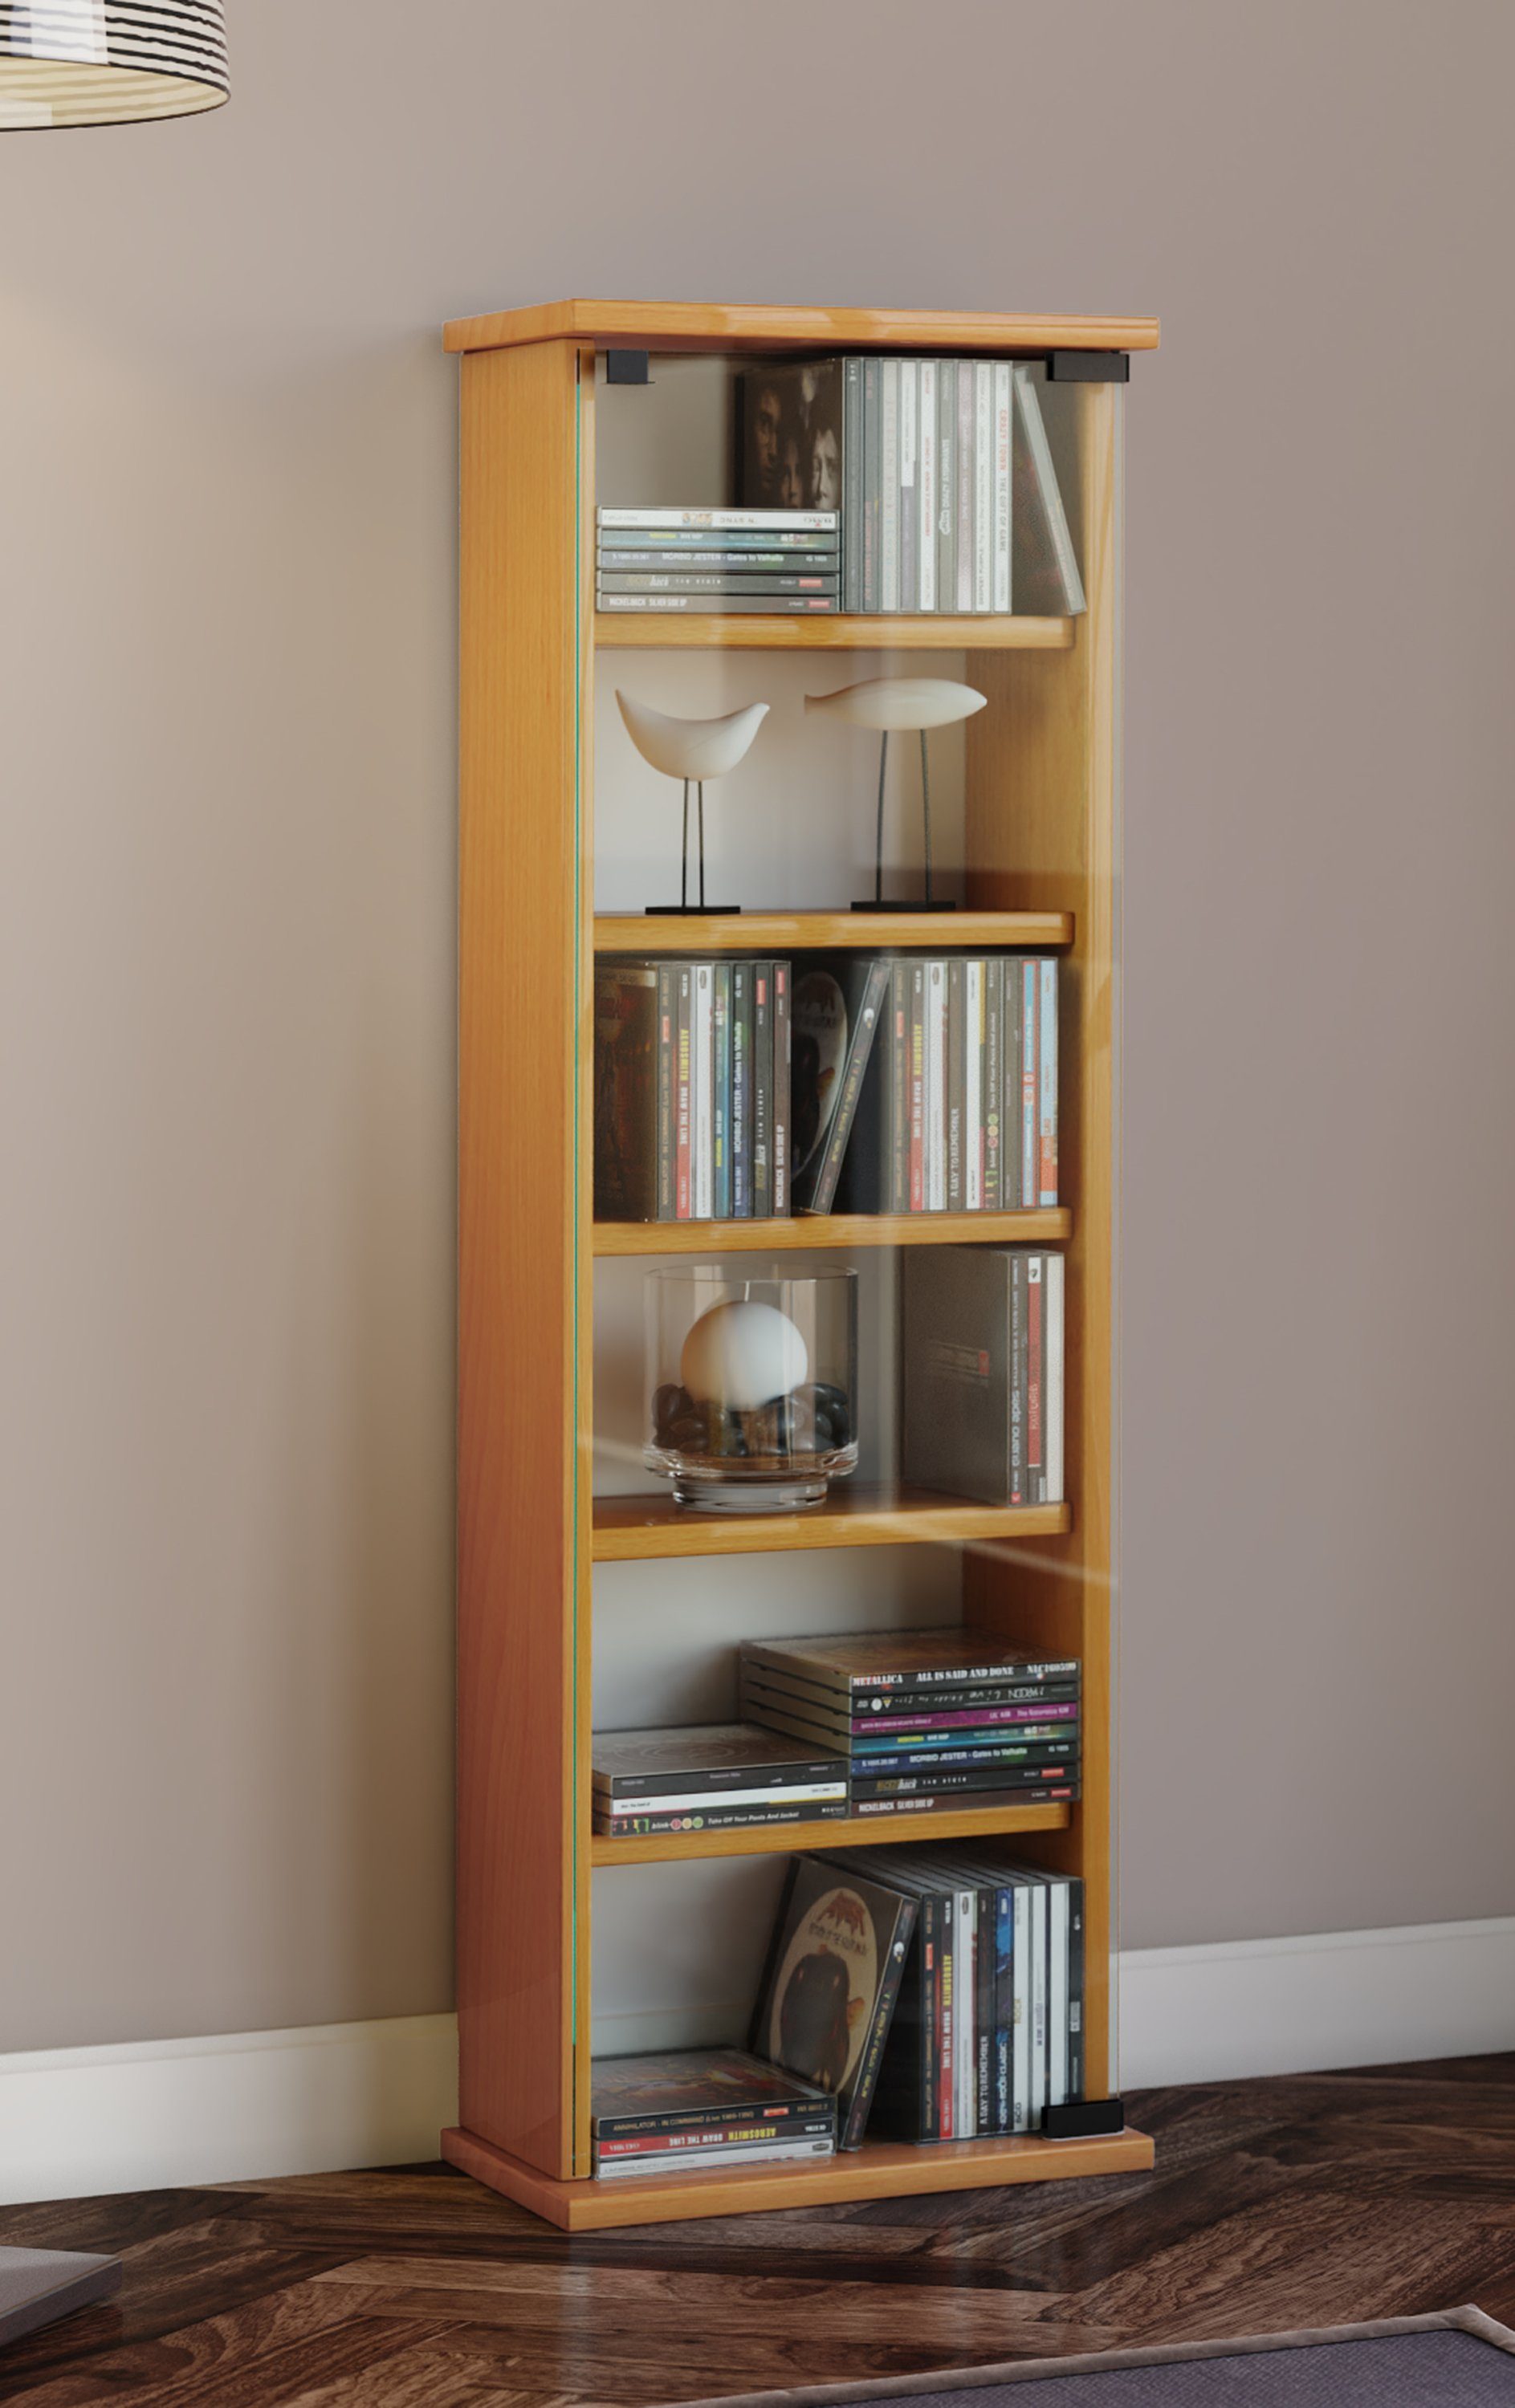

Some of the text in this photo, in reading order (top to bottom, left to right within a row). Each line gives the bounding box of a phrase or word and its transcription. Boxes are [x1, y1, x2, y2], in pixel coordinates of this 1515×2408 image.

[998, 443, 1008, 470] TOWN
[913, 1024, 922, 1076] AEROSMITH
[679, 1029, 688, 1145] AEROSMITH DRAW THE LINE
[951, 1108, 959, 1158] REMEMBER
[951, 1158, 959, 1169] TO
[951, 1171, 959, 1189] DAY
[1012, 1389, 1020, 1423] apes
[853, 1666, 1014, 1686] METALLICA ALL IS SAID AND DONE
[939, 1751, 967, 1762] JESTER
[972, 1750, 992, 1759] Gates
[1001, 1747, 1028, 1756] Valhalla
[858, 1802, 894, 1812] NICKELBACK
[707, 1817, 723, 1826] Take
[733, 1816, 748, 1824] Your
[747, 1813, 767, 1822] Pants
[768, 1812, 779, 1820] And
[780, 1811, 799, 1820] Jacket
[943, 1955, 952, 2068] AEROSMITH DRAW THE LINE
[979, 2036, 988, 2084] REMEMBER
[998, 2042, 1007, 2073] CLASSIC
[979, 2085, 988, 2097] TO
[979, 2099, 988, 2117] DAY
[613, 2121, 657, 2132] ANNIHILATOR
[669, 2127, 776, 2147] AEROSMITH DRAW THE LINE
